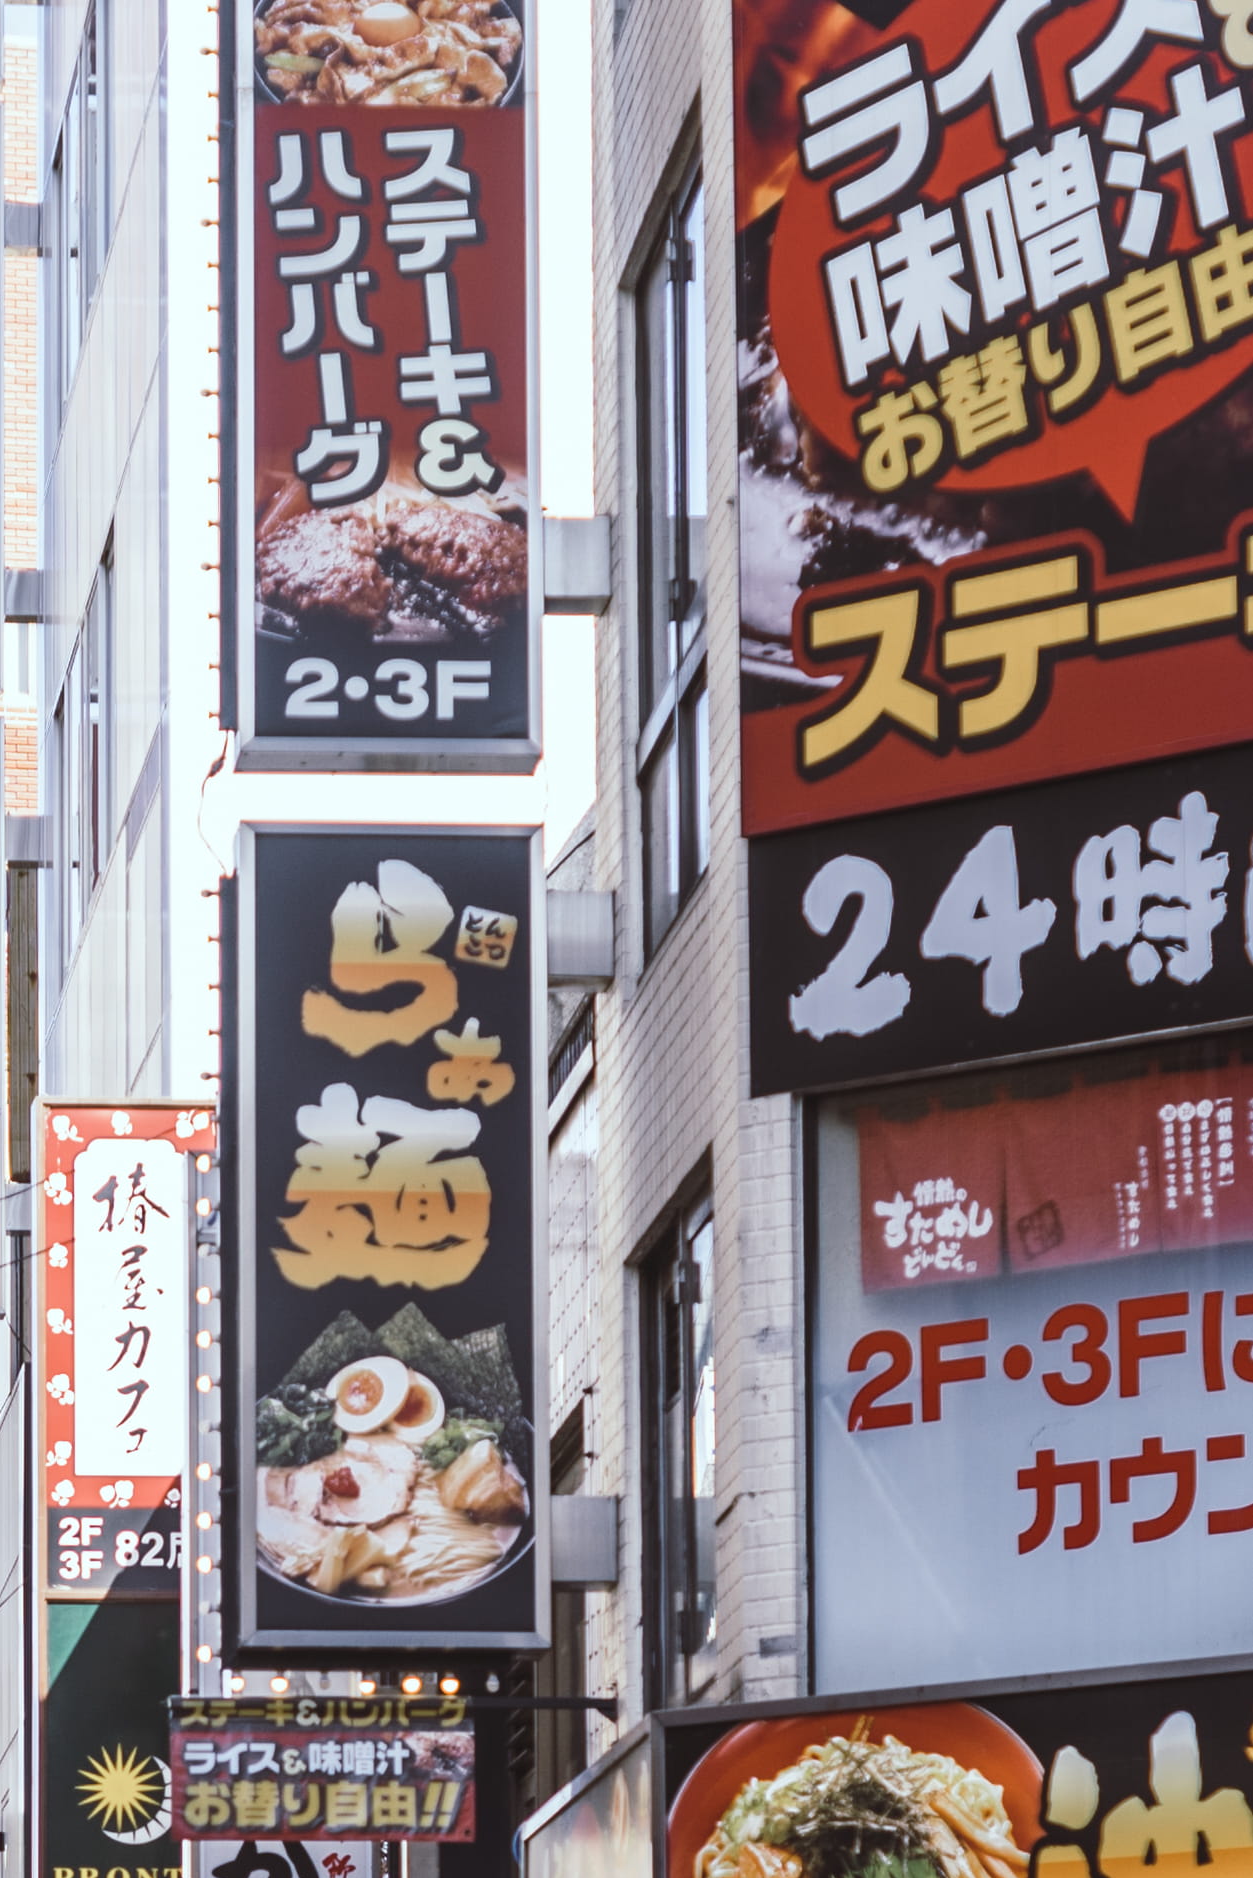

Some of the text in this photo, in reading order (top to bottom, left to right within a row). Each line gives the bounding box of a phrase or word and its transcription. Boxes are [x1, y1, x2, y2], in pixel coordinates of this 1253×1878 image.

[826, 63, 1246, 387] 味噌汁
[269, 131, 382, 501] ハンバーグ
[93, 1162, 170, 1453] 椿屋カフェ
[58, 1517, 104, 1545] 2F
[60, 1551, 104, 1579] 3F
[184, 1741, 410, 1777] ライス&味噌汁
[185, 1781, 462, 1831] お替り自由!!
